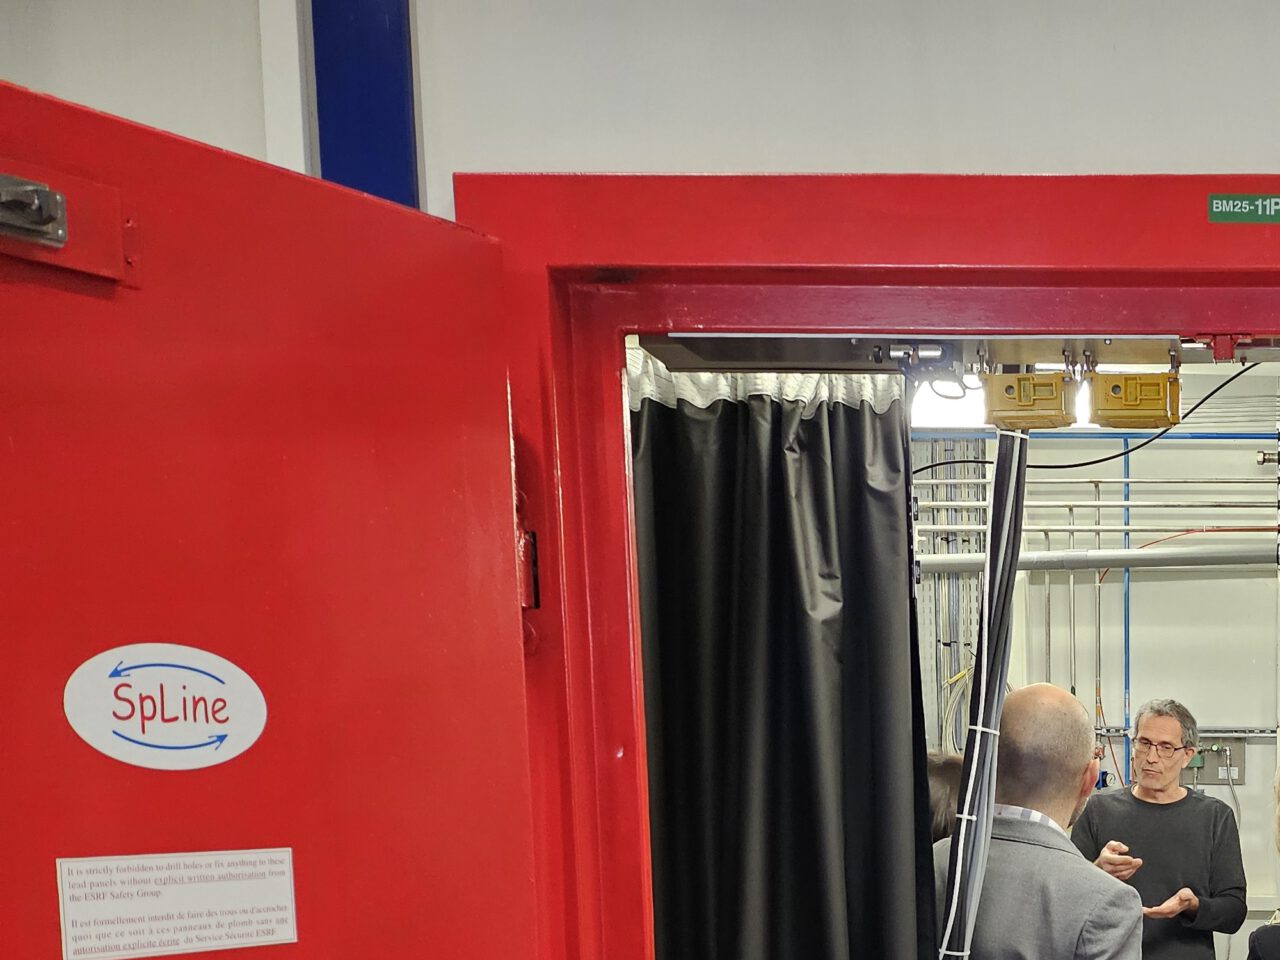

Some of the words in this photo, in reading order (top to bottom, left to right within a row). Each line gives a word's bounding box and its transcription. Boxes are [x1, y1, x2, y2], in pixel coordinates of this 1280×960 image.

[112, 682, 230, 735] SpLine
[67, 867, 74, 876] It
[76, 866, 83, 875] is
[85, 865, 113, 877] strictly
[116, 863, 153, 873] forbidden
[156, 862, 164, 871] to
[165, 862, 181, 870] drill
[183, 860, 203, 870] holes
[215, 859, 224, 868] fix
[227, 858, 257, 869] anything
[259, 857, 266, 866] to
[68, 880, 87, 889] lead
[89, 878, 117, 890] panels
[120, 876, 151, 886] without
[69, 893, 82, 902] the
[85, 892, 108, 901] ESRF
[110, 890, 134, 901] Safety
[71, 920, 78, 928] Il
[80, 919, 91, 927] est
[93, 914, 145, 926] formellement
[206, 909, 218, 917] des
[72, 932, 92, 944] quoi
[96, 932, 112, 941] que
[129, 928, 145, 936] soit
[184, 936, 193, 944] du
[195, 933, 222, 943] Service
